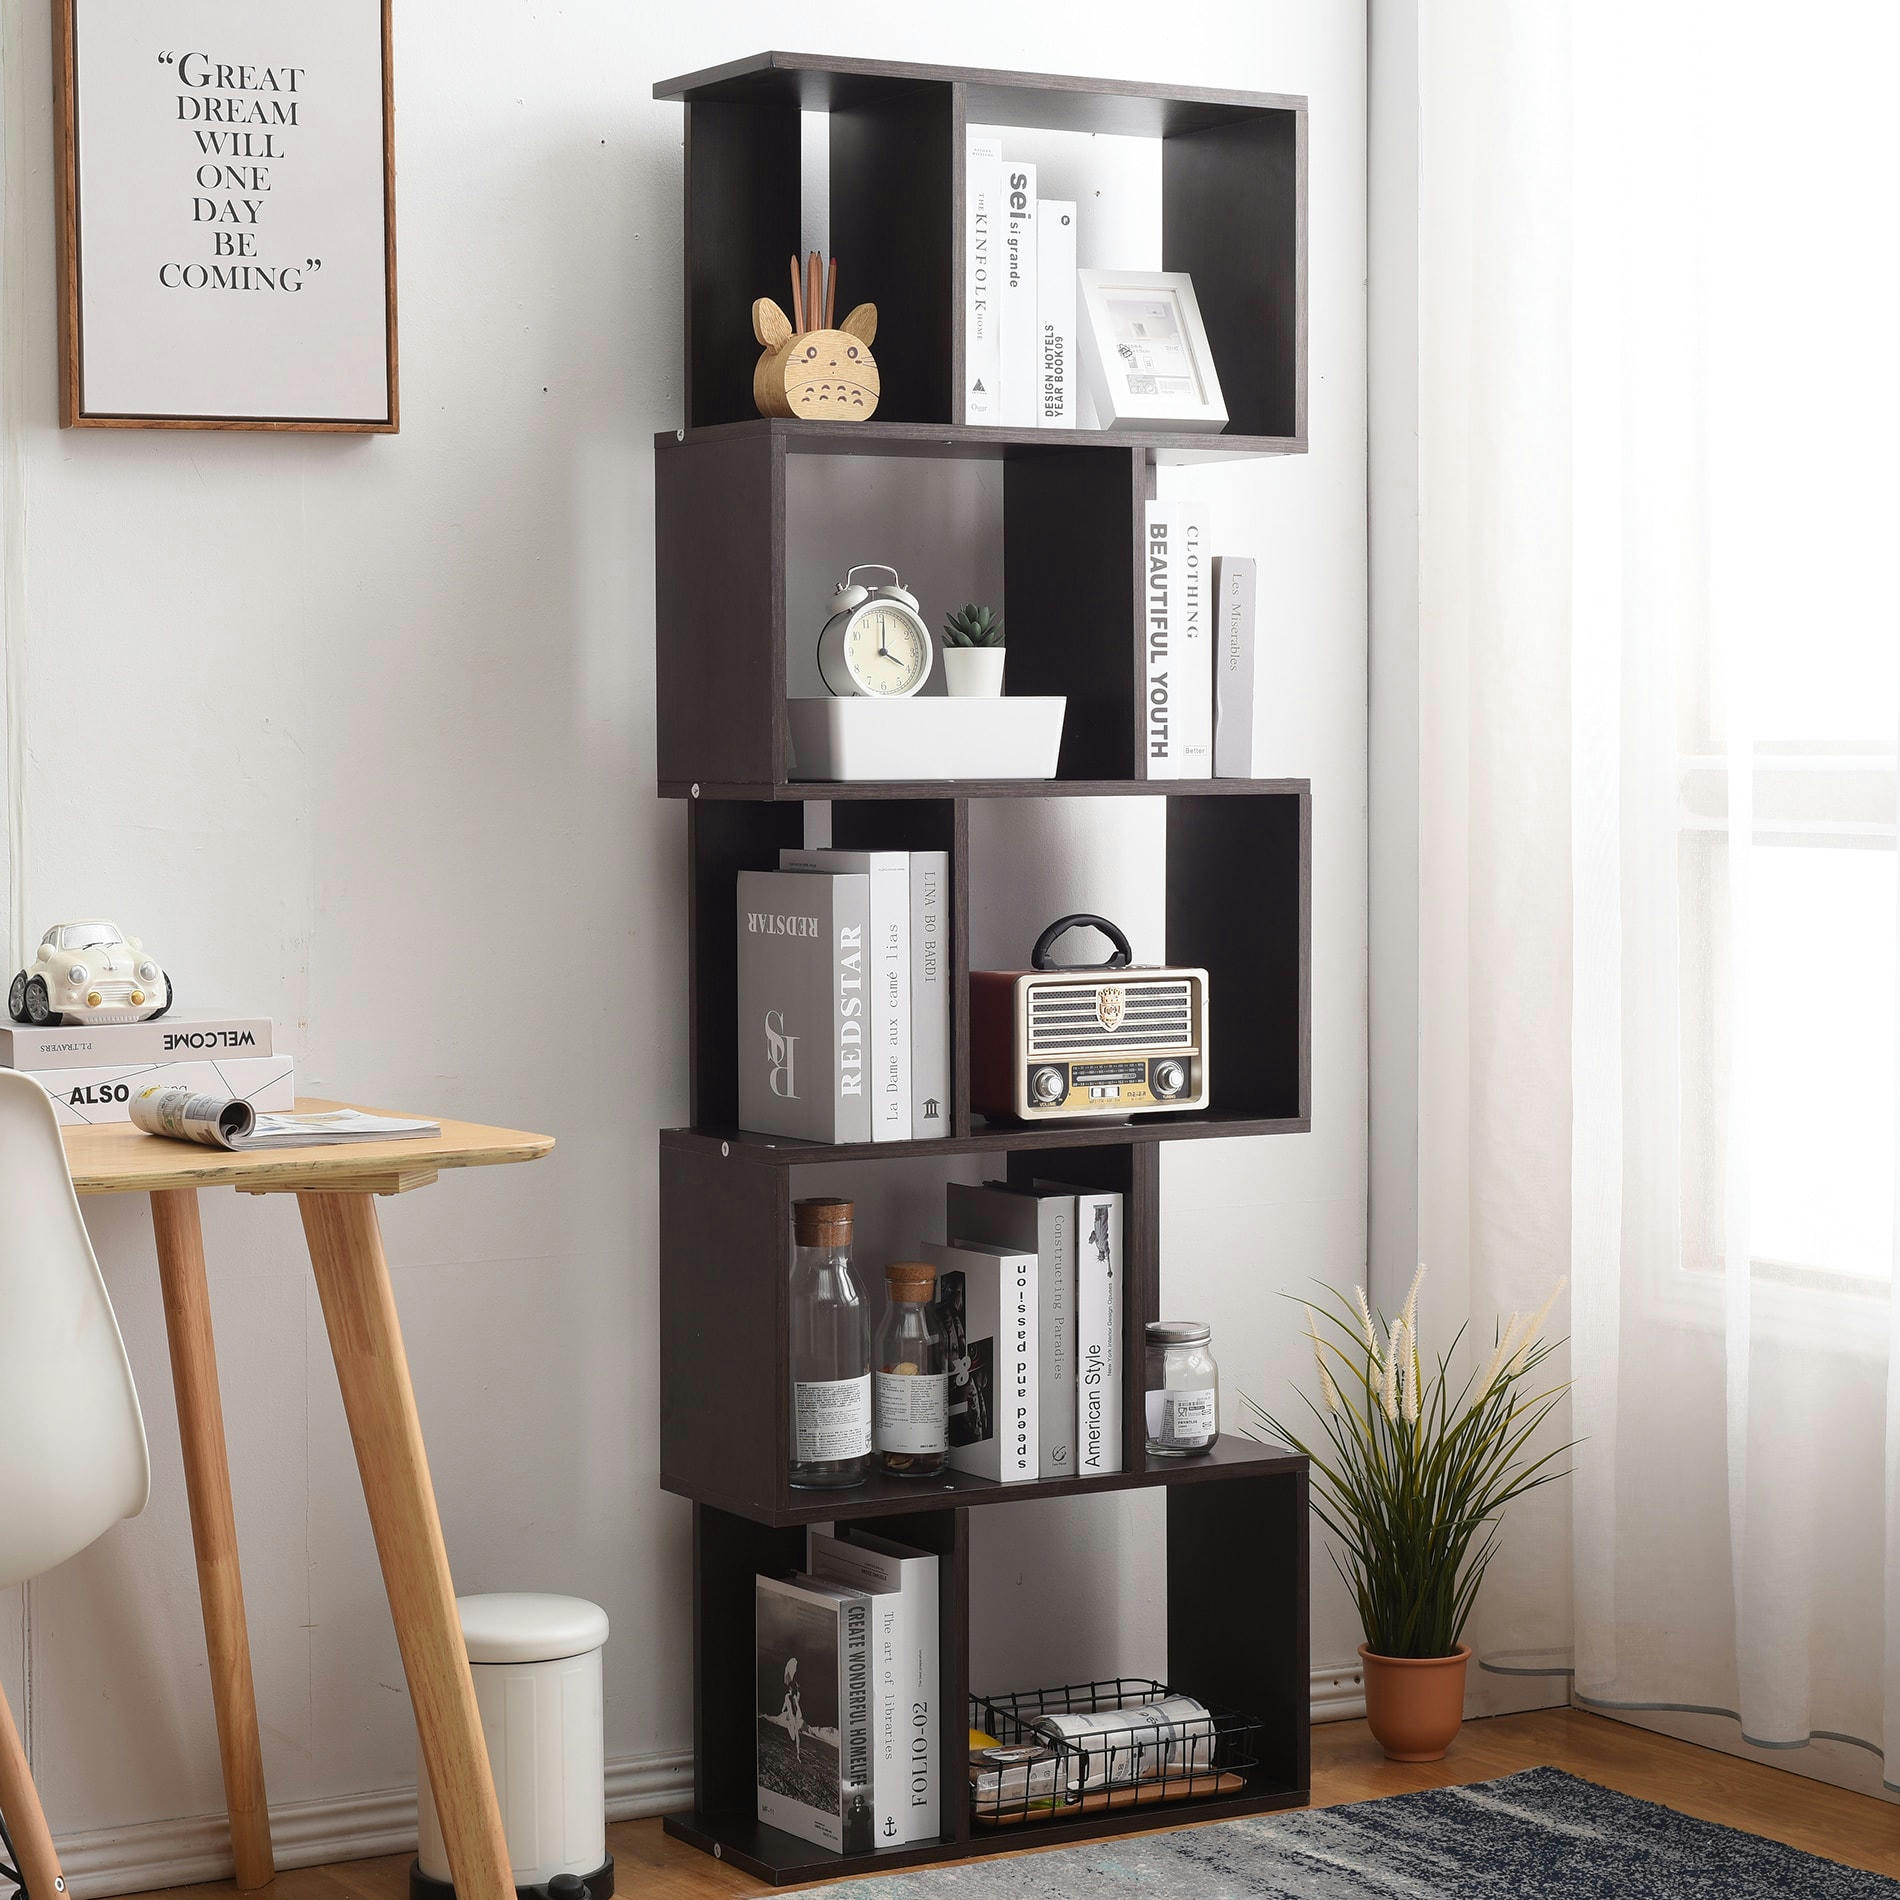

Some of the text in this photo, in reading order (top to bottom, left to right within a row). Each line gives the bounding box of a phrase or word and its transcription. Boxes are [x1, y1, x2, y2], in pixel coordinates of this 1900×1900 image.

[176, 95, 298, 125] DREAM
[193, 130, 285, 158] WILL
[196, 164, 271, 191] ONE
[192, 197, 264, 224] DAY
[212, 231, 258, 257] BE
[1007, 172, 1031, 287] sei si grande
[974, 193, 988, 340] THE KINFOLK HOME
[1044, 374, 1054, 417] DESIGN
[1054, 387, 1064, 417] YEAR
[1186, 525, 1199, 639] CLOTHING
[904, 631, 910, 640] 2
[1229, 573, 1243, 672] Les Miserables
[848, 647, 854, 656] 9
[909, 648, 916, 657] 3
[1150, 523, 1168, 758] BEAUTIFUL YOUTH
[854, 664, 860, 673] 8
[905, 664, 911, 673] 4
[881, 681, 887, 690] 6
[1185, 747, 1205, 755] Better
[747, 912, 819, 938] REDSTAR
[924, 871, 937, 983] LINA BO BARDI
[840, 923, 862, 1097] REDSTAR
[885, 923, 898, 1121] La Dame aux camé lias
[163, 1031, 255, 1050] WELCOME
[69, 1084, 130, 1105] ALSO
[1053, 1215, 1065, 1381] Constructing Paradies
[1017, 1264, 1026, 1469] speed and passion
[1084, 1344, 1104, 1467] American Style
[848, 1606, 868, 1787] CREATE WONDERFUL HOMELIFE
[884, 1611, 895, 1760] The art of libraries
[912, 1702, 928, 1808] FOLIO-02
